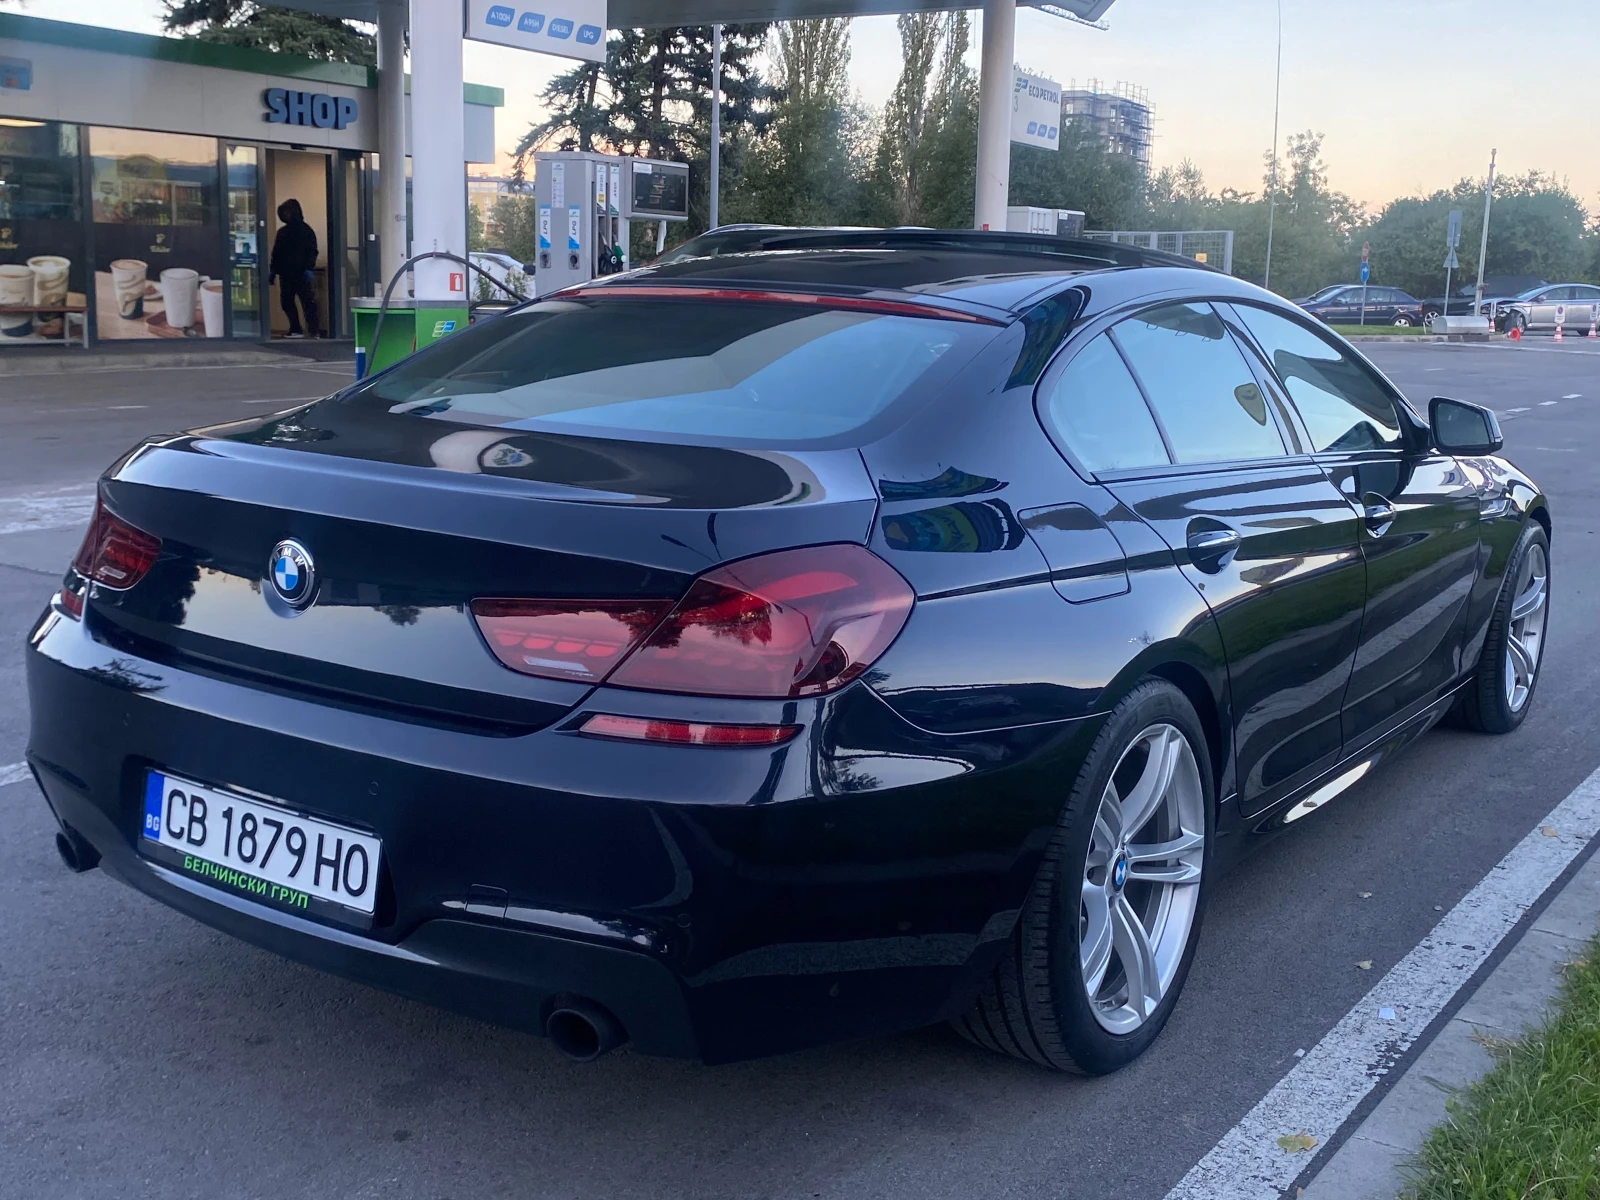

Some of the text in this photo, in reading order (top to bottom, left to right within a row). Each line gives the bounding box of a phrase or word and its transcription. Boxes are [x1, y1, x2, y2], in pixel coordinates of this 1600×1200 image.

[552, 23, 570, 34] DIESEL
[583, 30, 595, 40] LPG
[265, 87, 358, 130] SHOP
[1028, 84, 1060, 104] ECOPETROL
[146, 813, 160, 831] BG
[166, 789, 369, 897] CB 1879 HO
[183, 855, 310, 909] БЕЛЧИНСКИ ГРУП
